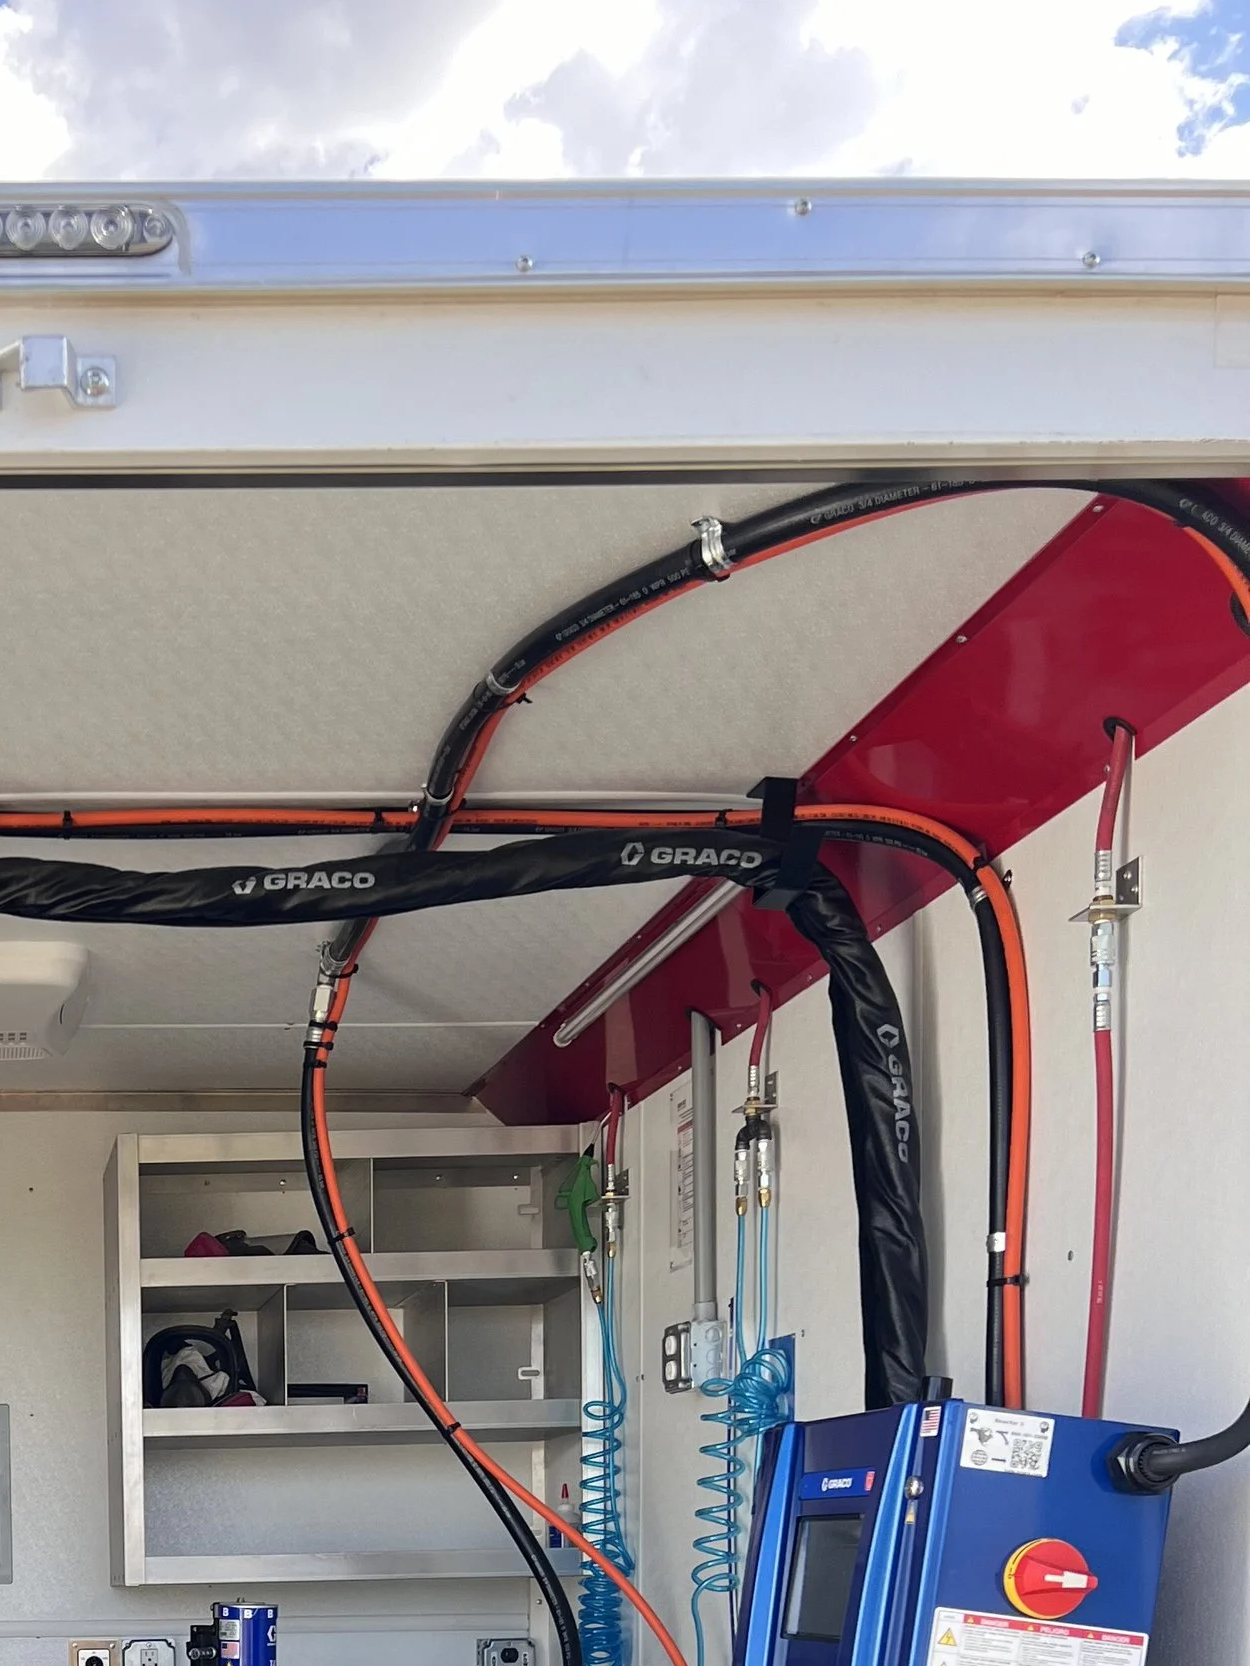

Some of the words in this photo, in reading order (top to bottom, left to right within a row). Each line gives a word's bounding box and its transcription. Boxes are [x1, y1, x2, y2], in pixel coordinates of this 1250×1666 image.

[650, 844, 763, 869] GRACO
[263, 870, 376, 891] GRACO
[888, 1054, 911, 1163] GRACO
[243, 1609, 253, 1619] B
[267, 1609, 274, 1619] B
